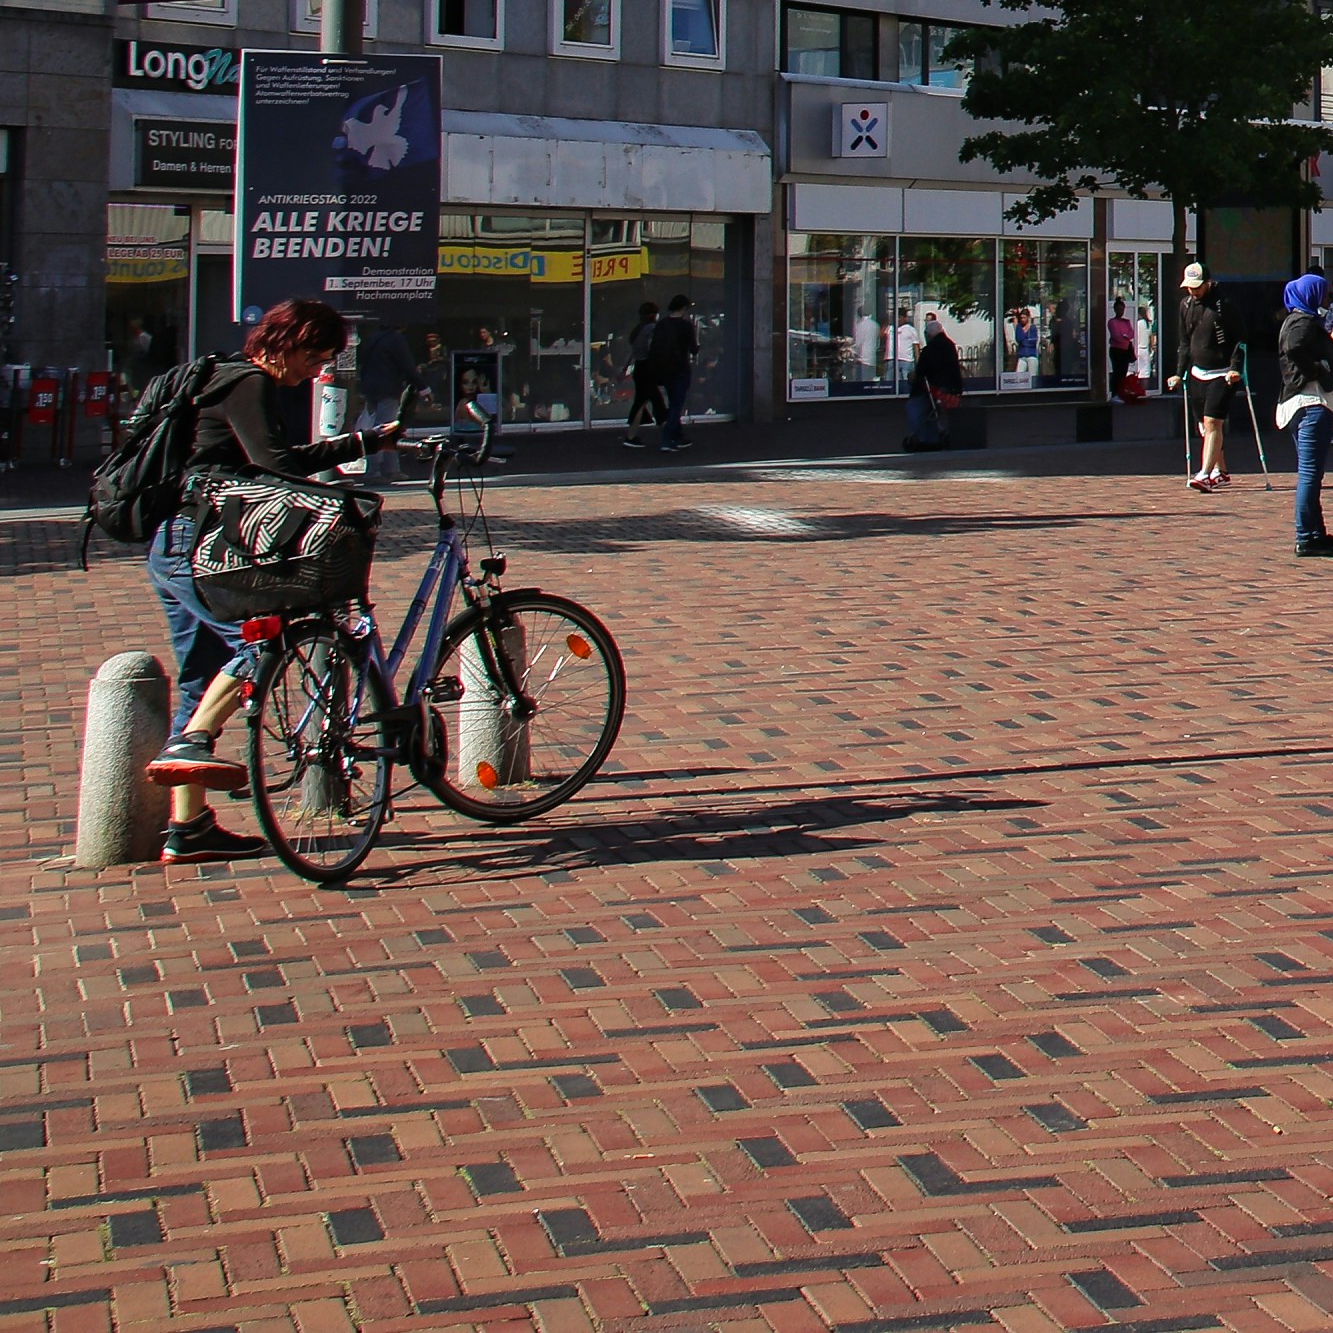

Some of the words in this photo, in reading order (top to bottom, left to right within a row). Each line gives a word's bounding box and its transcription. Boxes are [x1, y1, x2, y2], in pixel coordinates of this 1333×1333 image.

[255, 66, 268, 74] Für
[270, 66, 327, 74] Waffenstillstand
[255, 74, 281, 83] Gegen
[325, 74, 364, 82] Sanktionen
[148, 130, 216, 149] STYLING
[152, 160, 188, 171] Damen
[190, 162, 198, 172] &
[200, 162, 231, 174] Herren
[258, 195, 347, 205] ANTIKRIEGSTAG
[349, 195, 378, 204] 2022
[251, 211, 319, 233] ALLE
[326, 211, 425, 233] KRIEGE
[252, 236, 392, 259] BEENDEN!
[362, 267, 434, 276] Demonstration
[329, 279, 338, 288] 1.
[341, 278, 395, 289] September,
[400, 278, 412, 287] 17
[415, 278, 434, 288] Uhr
[356, 291, 433, 301] Hachmannplatz
